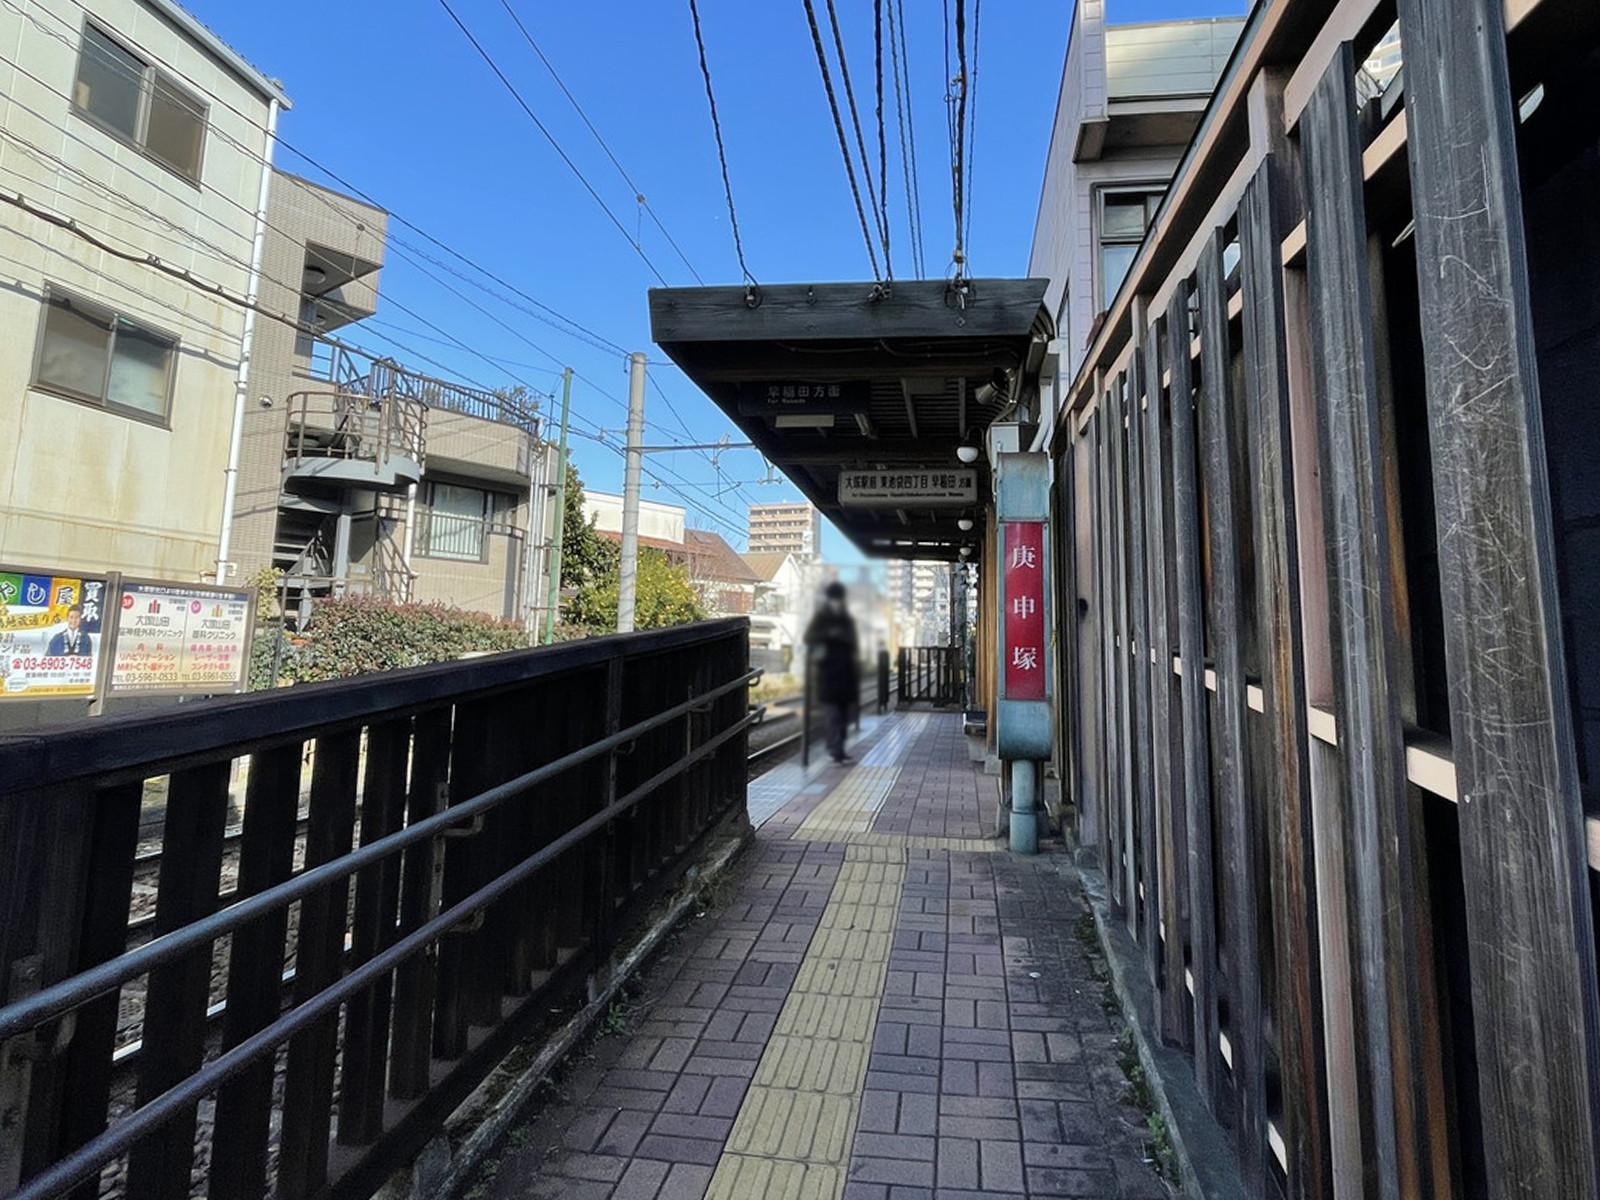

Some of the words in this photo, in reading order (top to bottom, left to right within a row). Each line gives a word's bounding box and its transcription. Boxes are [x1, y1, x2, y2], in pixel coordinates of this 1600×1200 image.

[768, 386, 840, 398] 早稲田方面
[846, 475, 877, 489] 大塚駅前
[881, 475, 928, 489] 東池袋四丁目
[932, 475, 956, 488] 早稲田
[81, 582, 103, 622] 買取
[1011, 545, 1038, 670] 庚申塚
[23, 657, 93, 670] 03-6903-7548
